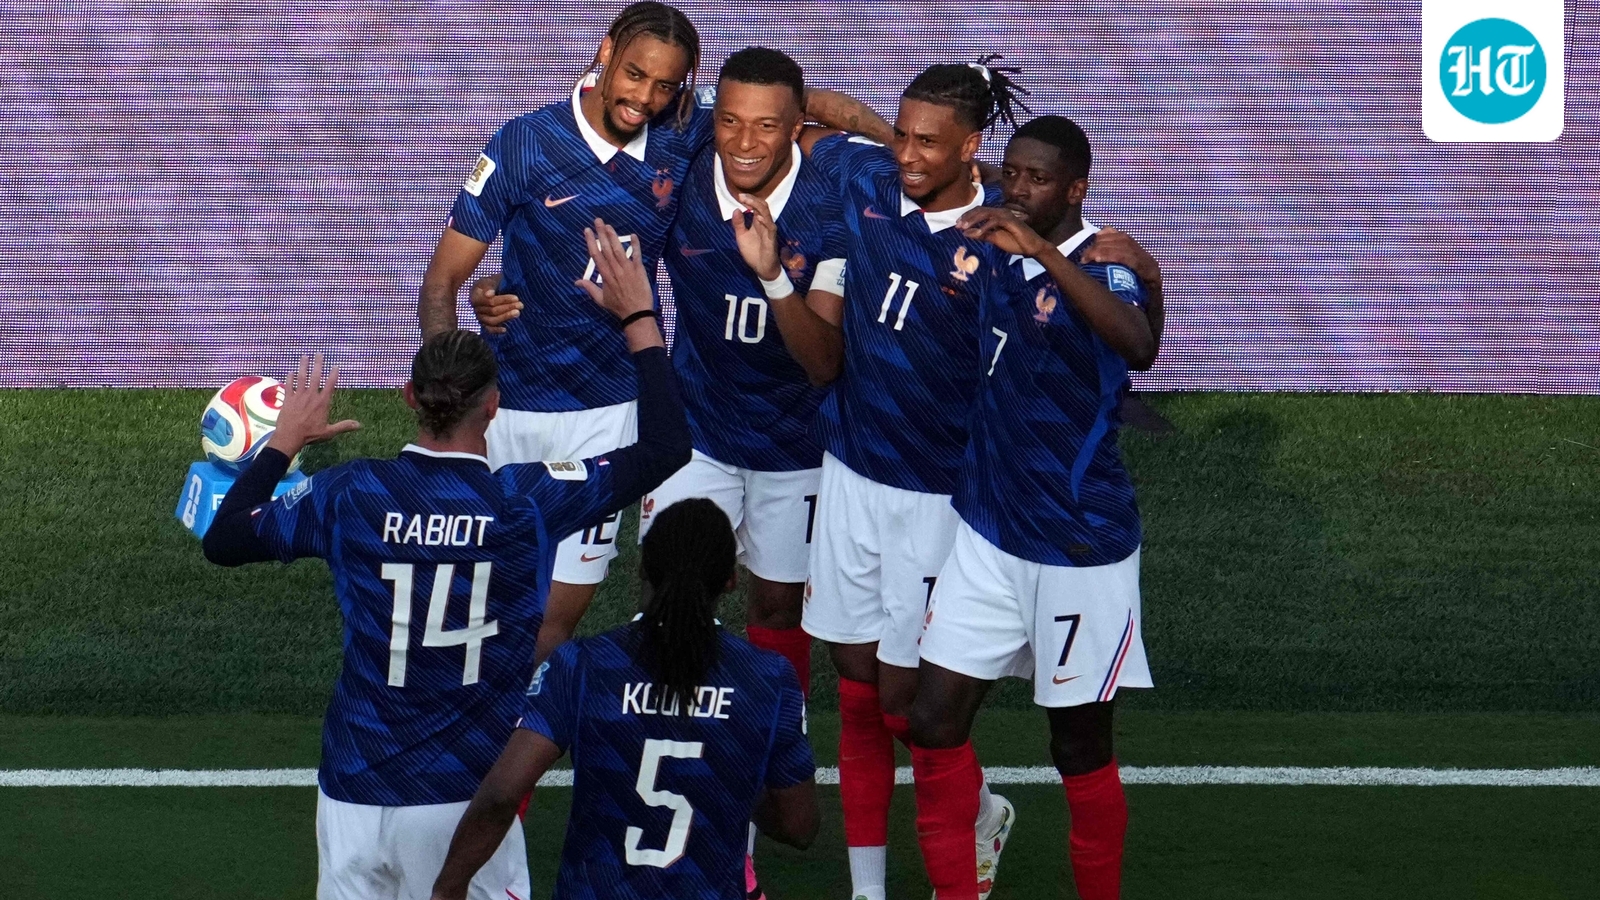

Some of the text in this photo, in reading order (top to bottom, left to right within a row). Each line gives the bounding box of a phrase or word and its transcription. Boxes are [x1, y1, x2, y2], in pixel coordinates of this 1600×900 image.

[724, 294, 768, 343] 10
[877, 272, 919, 331] 11
[987, 326, 1008, 377] 7
[383, 512, 494, 547] RABIOT
[381, 561, 499, 687] 14
[1054, 613, 1081, 667] 7
[624, 738, 705, 869] 5
